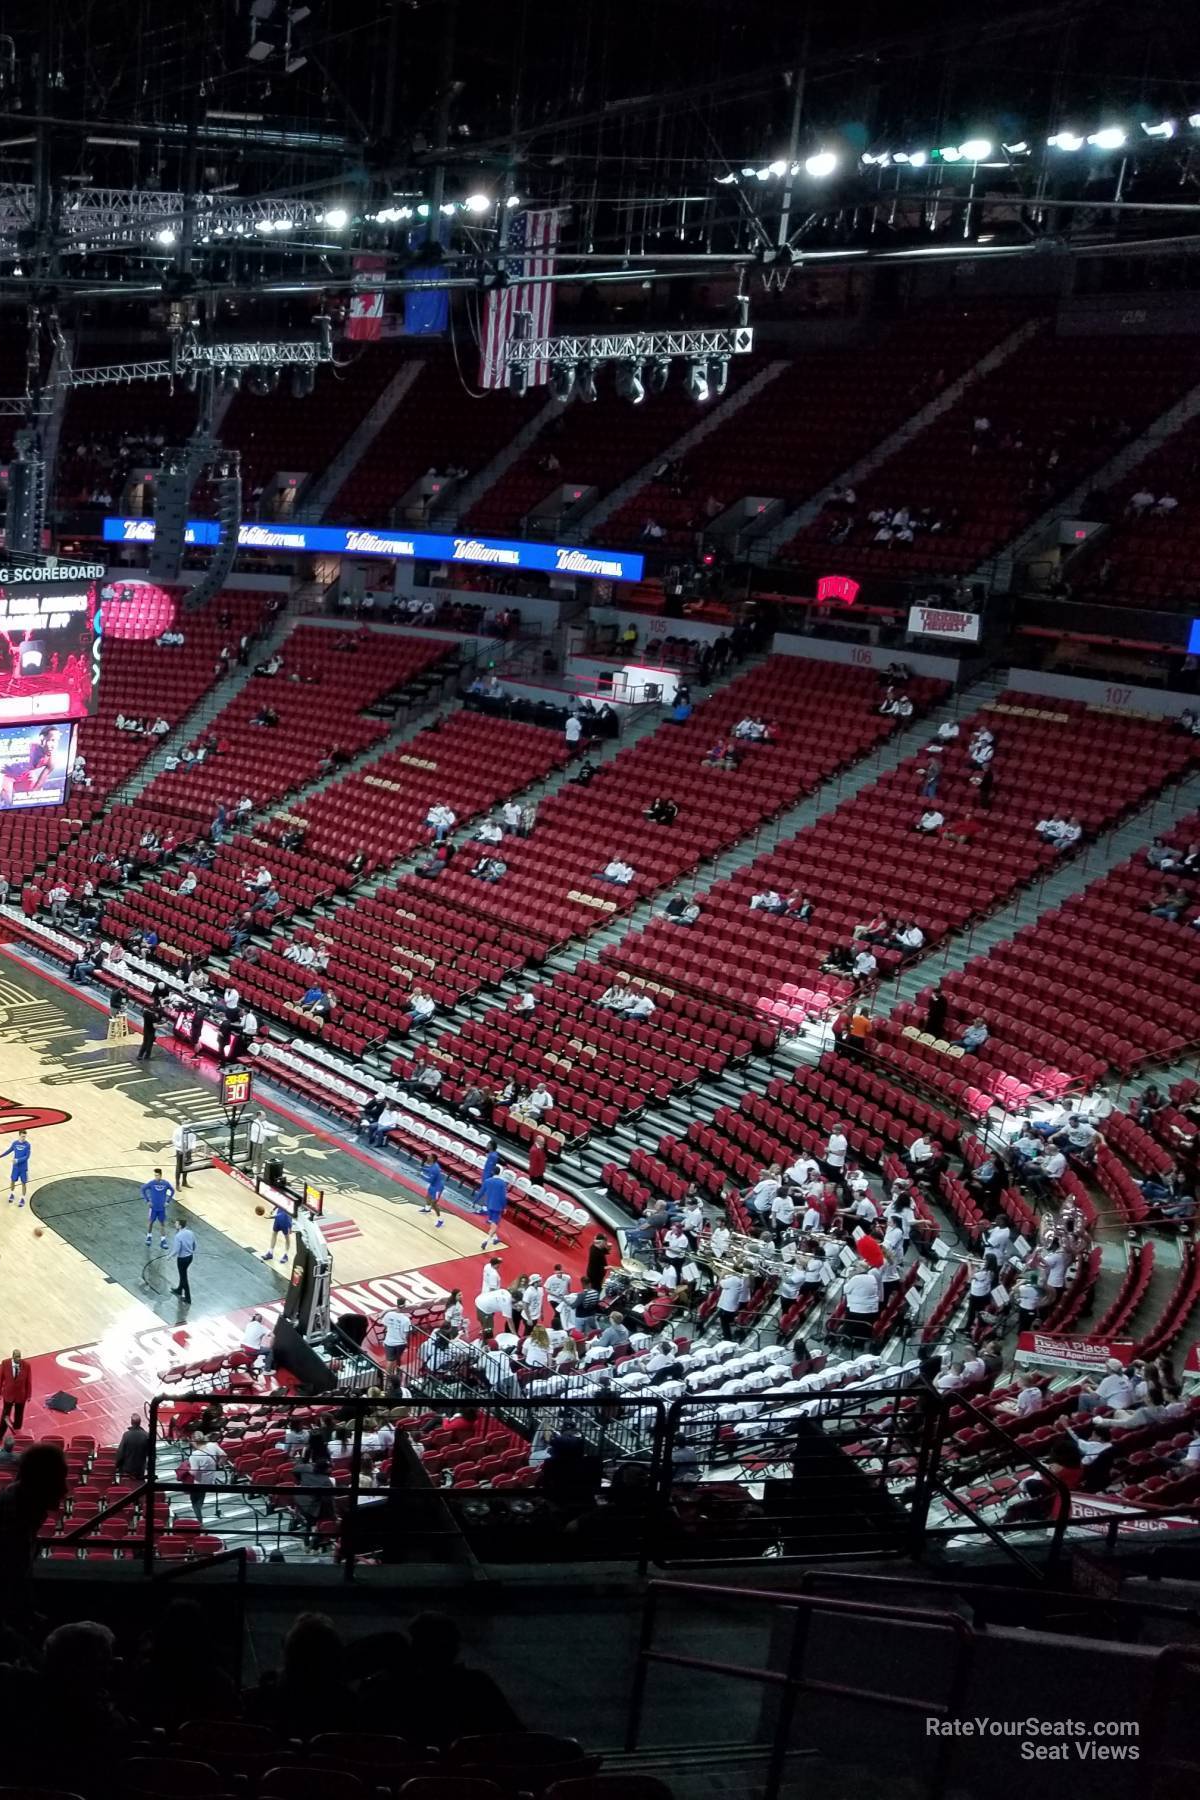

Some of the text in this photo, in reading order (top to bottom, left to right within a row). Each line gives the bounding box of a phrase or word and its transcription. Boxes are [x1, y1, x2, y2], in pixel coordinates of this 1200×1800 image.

[453, 539, 501, 562] William
[556, 549, 604, 575] William
[14, 565, 105, 581] SCOREBOARD
[650, 619, 667, 633] 105
[851, 648, 872, 664] 106
[1106, 687, 1132, 704] 107
[227, 1083, 245, 1102] 30
[1072, 1341, 1110, 1354] Place
